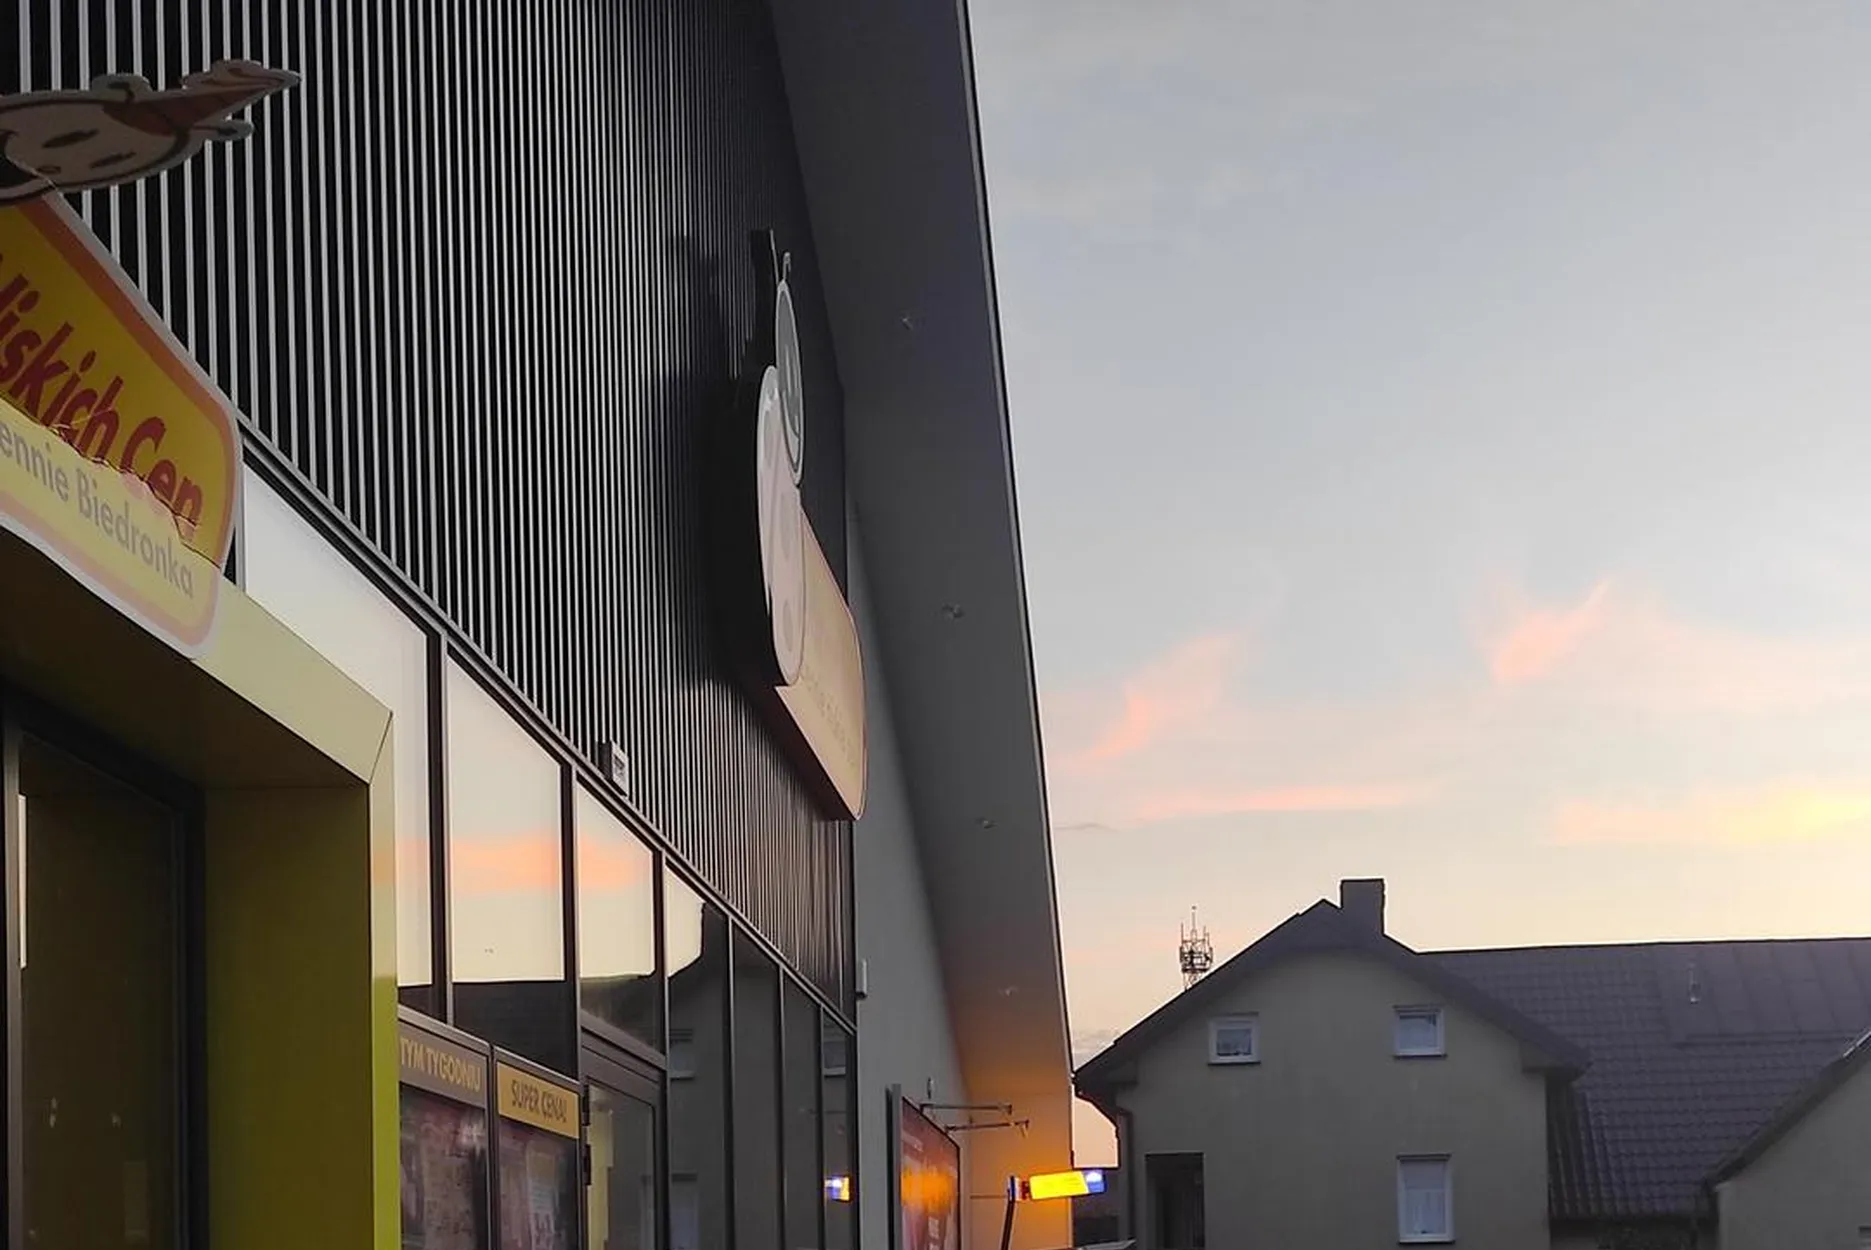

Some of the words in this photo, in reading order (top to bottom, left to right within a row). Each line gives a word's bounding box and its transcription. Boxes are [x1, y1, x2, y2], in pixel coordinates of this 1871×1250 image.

[120, 416, 203, 542] Cen
[76, 467, 193, 599] Biedronka
[400, 1036, 424, 1072] TYM
[425, 1047, 481, 1093] TYGODNIU
[511, 1078, 539, 1113] SUPER
[540, 1090, 568, 1123] CENA!
